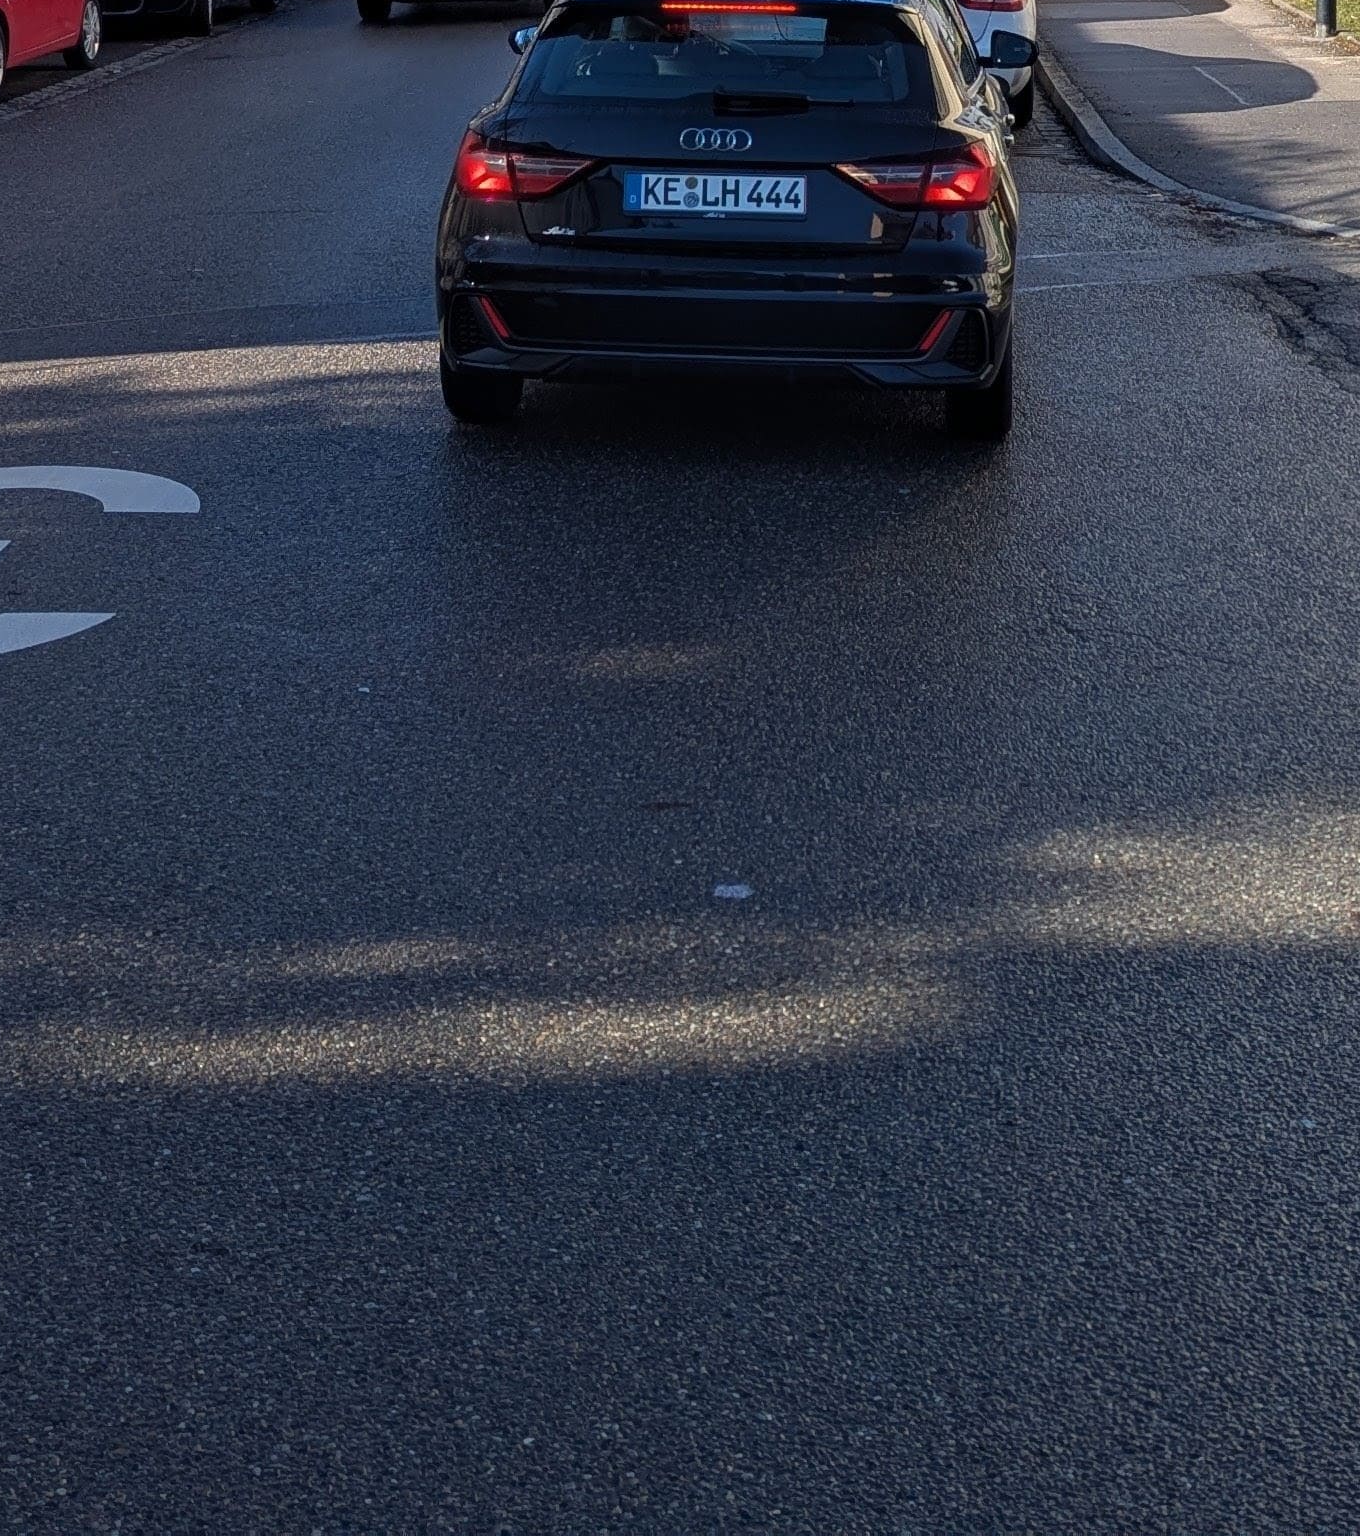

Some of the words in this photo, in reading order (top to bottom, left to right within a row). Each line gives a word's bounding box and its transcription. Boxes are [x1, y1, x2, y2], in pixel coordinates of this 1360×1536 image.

[644, 177, 682, 206] KE
[702, 178, 740, 207] LH
[747, 179, 801, 208] 444
